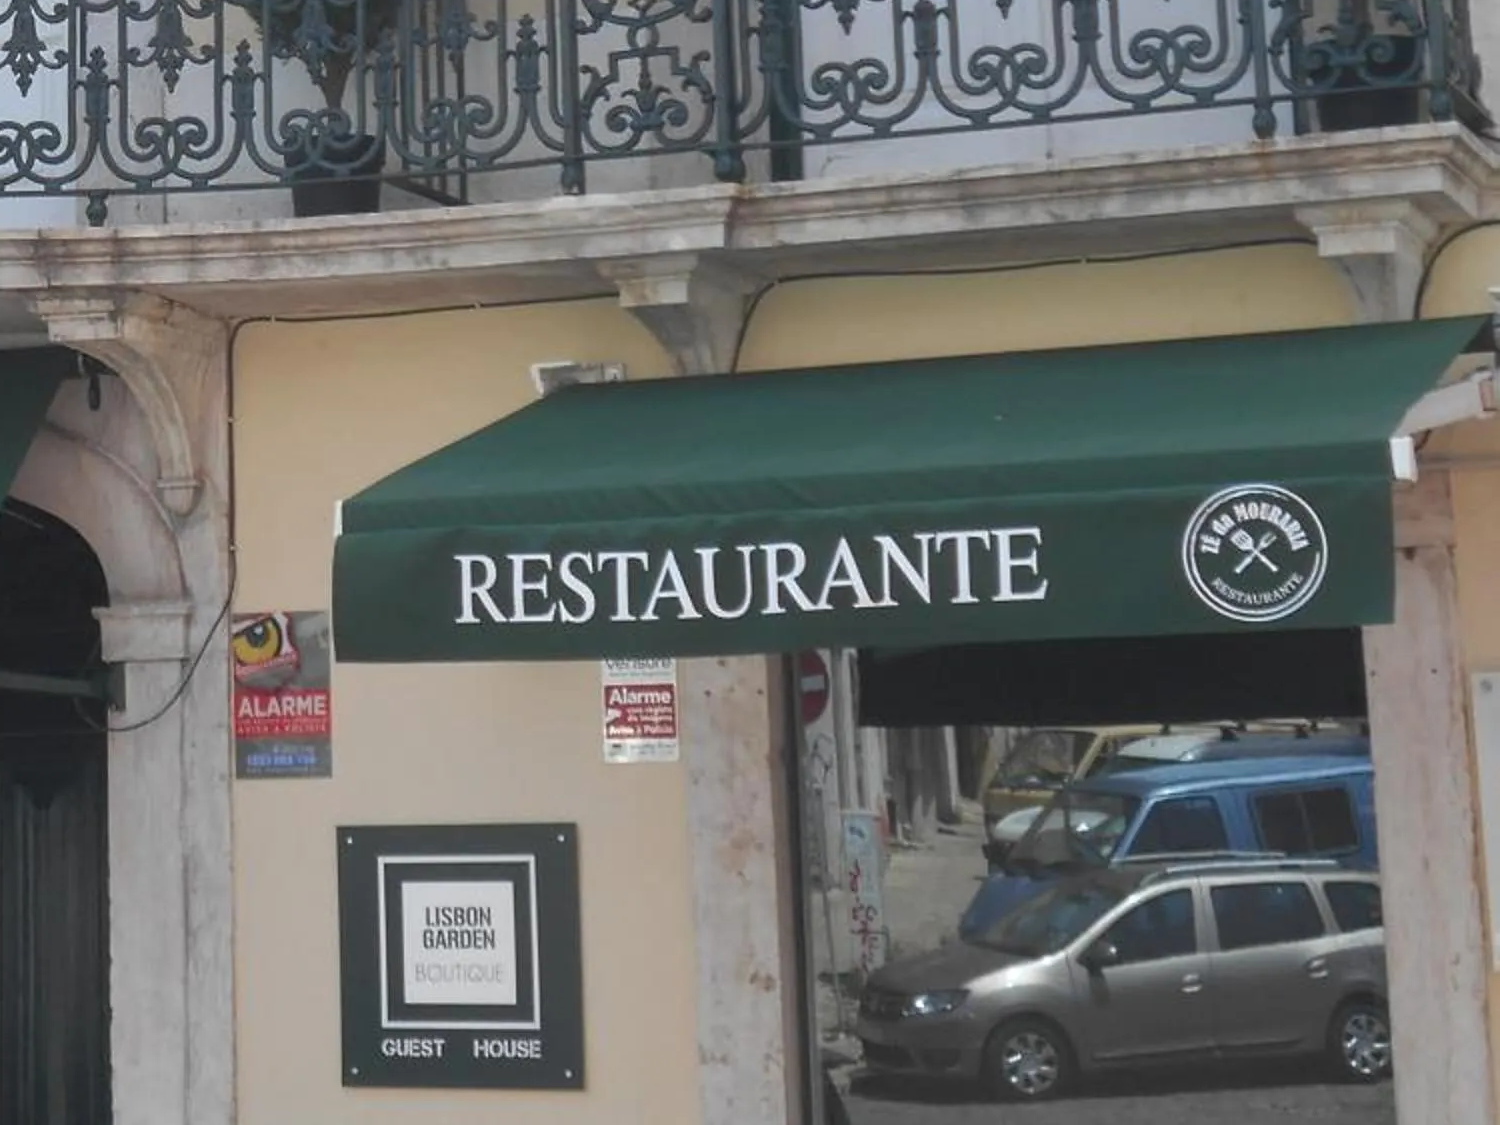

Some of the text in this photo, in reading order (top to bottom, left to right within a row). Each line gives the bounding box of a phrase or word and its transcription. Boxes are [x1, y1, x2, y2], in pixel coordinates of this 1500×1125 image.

[1232, 501, 1310, 552] MOURARIA
[453, 527, 1048, 625] RESTAURANTE
[1211, 572, 1304, 605] RESTAURANTE
[238, 694, 328, 719] ALARME
[609, 687, 672, 705] Alarme
[425, 906, 492, 927] LISBON
[423, 928, 496, 950] GARDEN
[415, 962, 505, 984] BOUTIQUE
[381, 1038, 542, 1059] GUEST HOUSE
